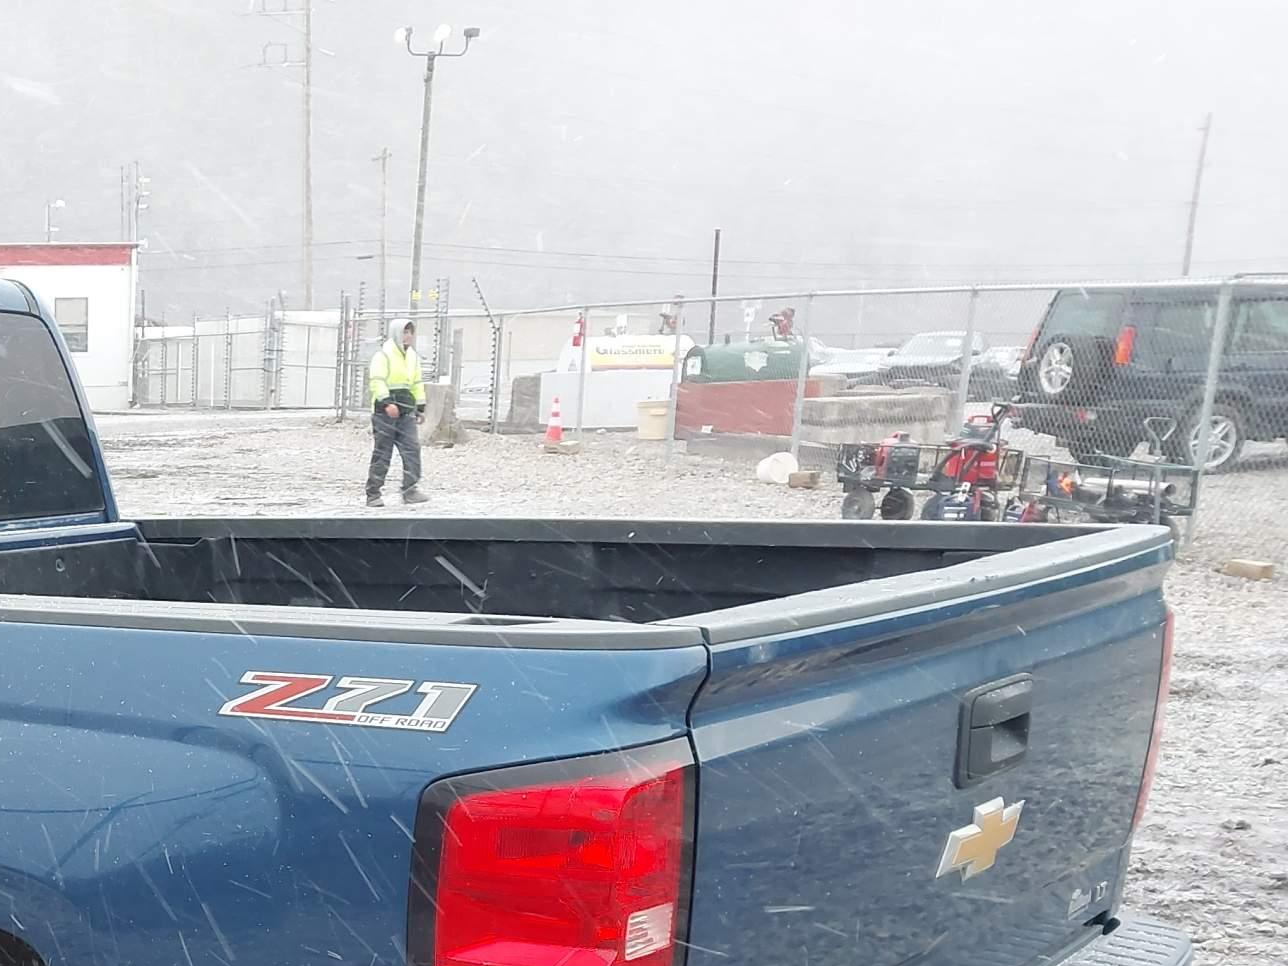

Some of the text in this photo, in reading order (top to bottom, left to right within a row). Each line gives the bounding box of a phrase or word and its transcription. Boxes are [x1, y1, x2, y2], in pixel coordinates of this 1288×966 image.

[217, 670, 481, 724] Z71
[355, 714, 448, 731] OFF ROAD
